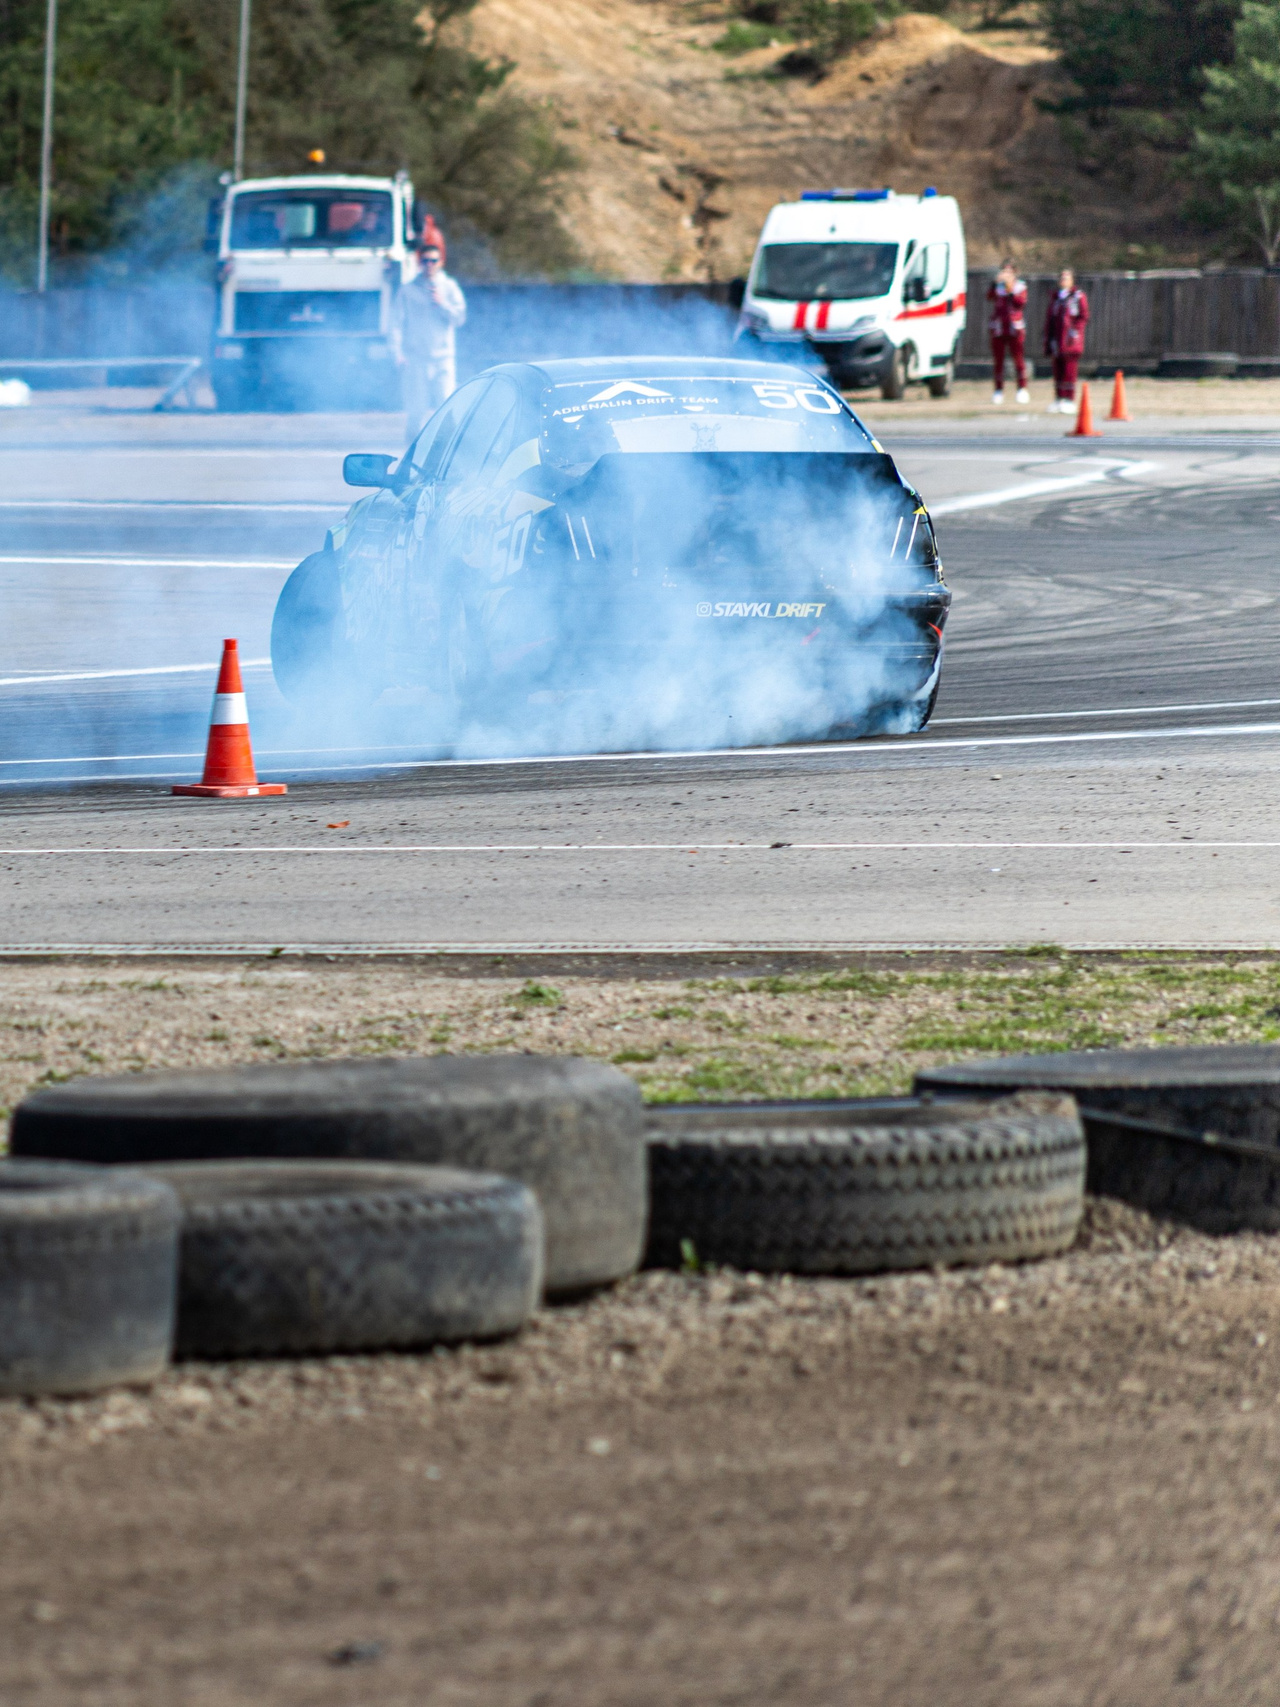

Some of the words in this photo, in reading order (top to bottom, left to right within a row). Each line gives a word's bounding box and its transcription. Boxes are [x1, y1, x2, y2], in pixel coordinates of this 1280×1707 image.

[552, 399, 631, 417] ADRENALIN
[636, 396, 676, 406] DRIFT
[679, 396, 719, 405] TEAM
[752, 384, 842, 415] 50
[712, 602, 827, 618] STAYKI_DRIFT
